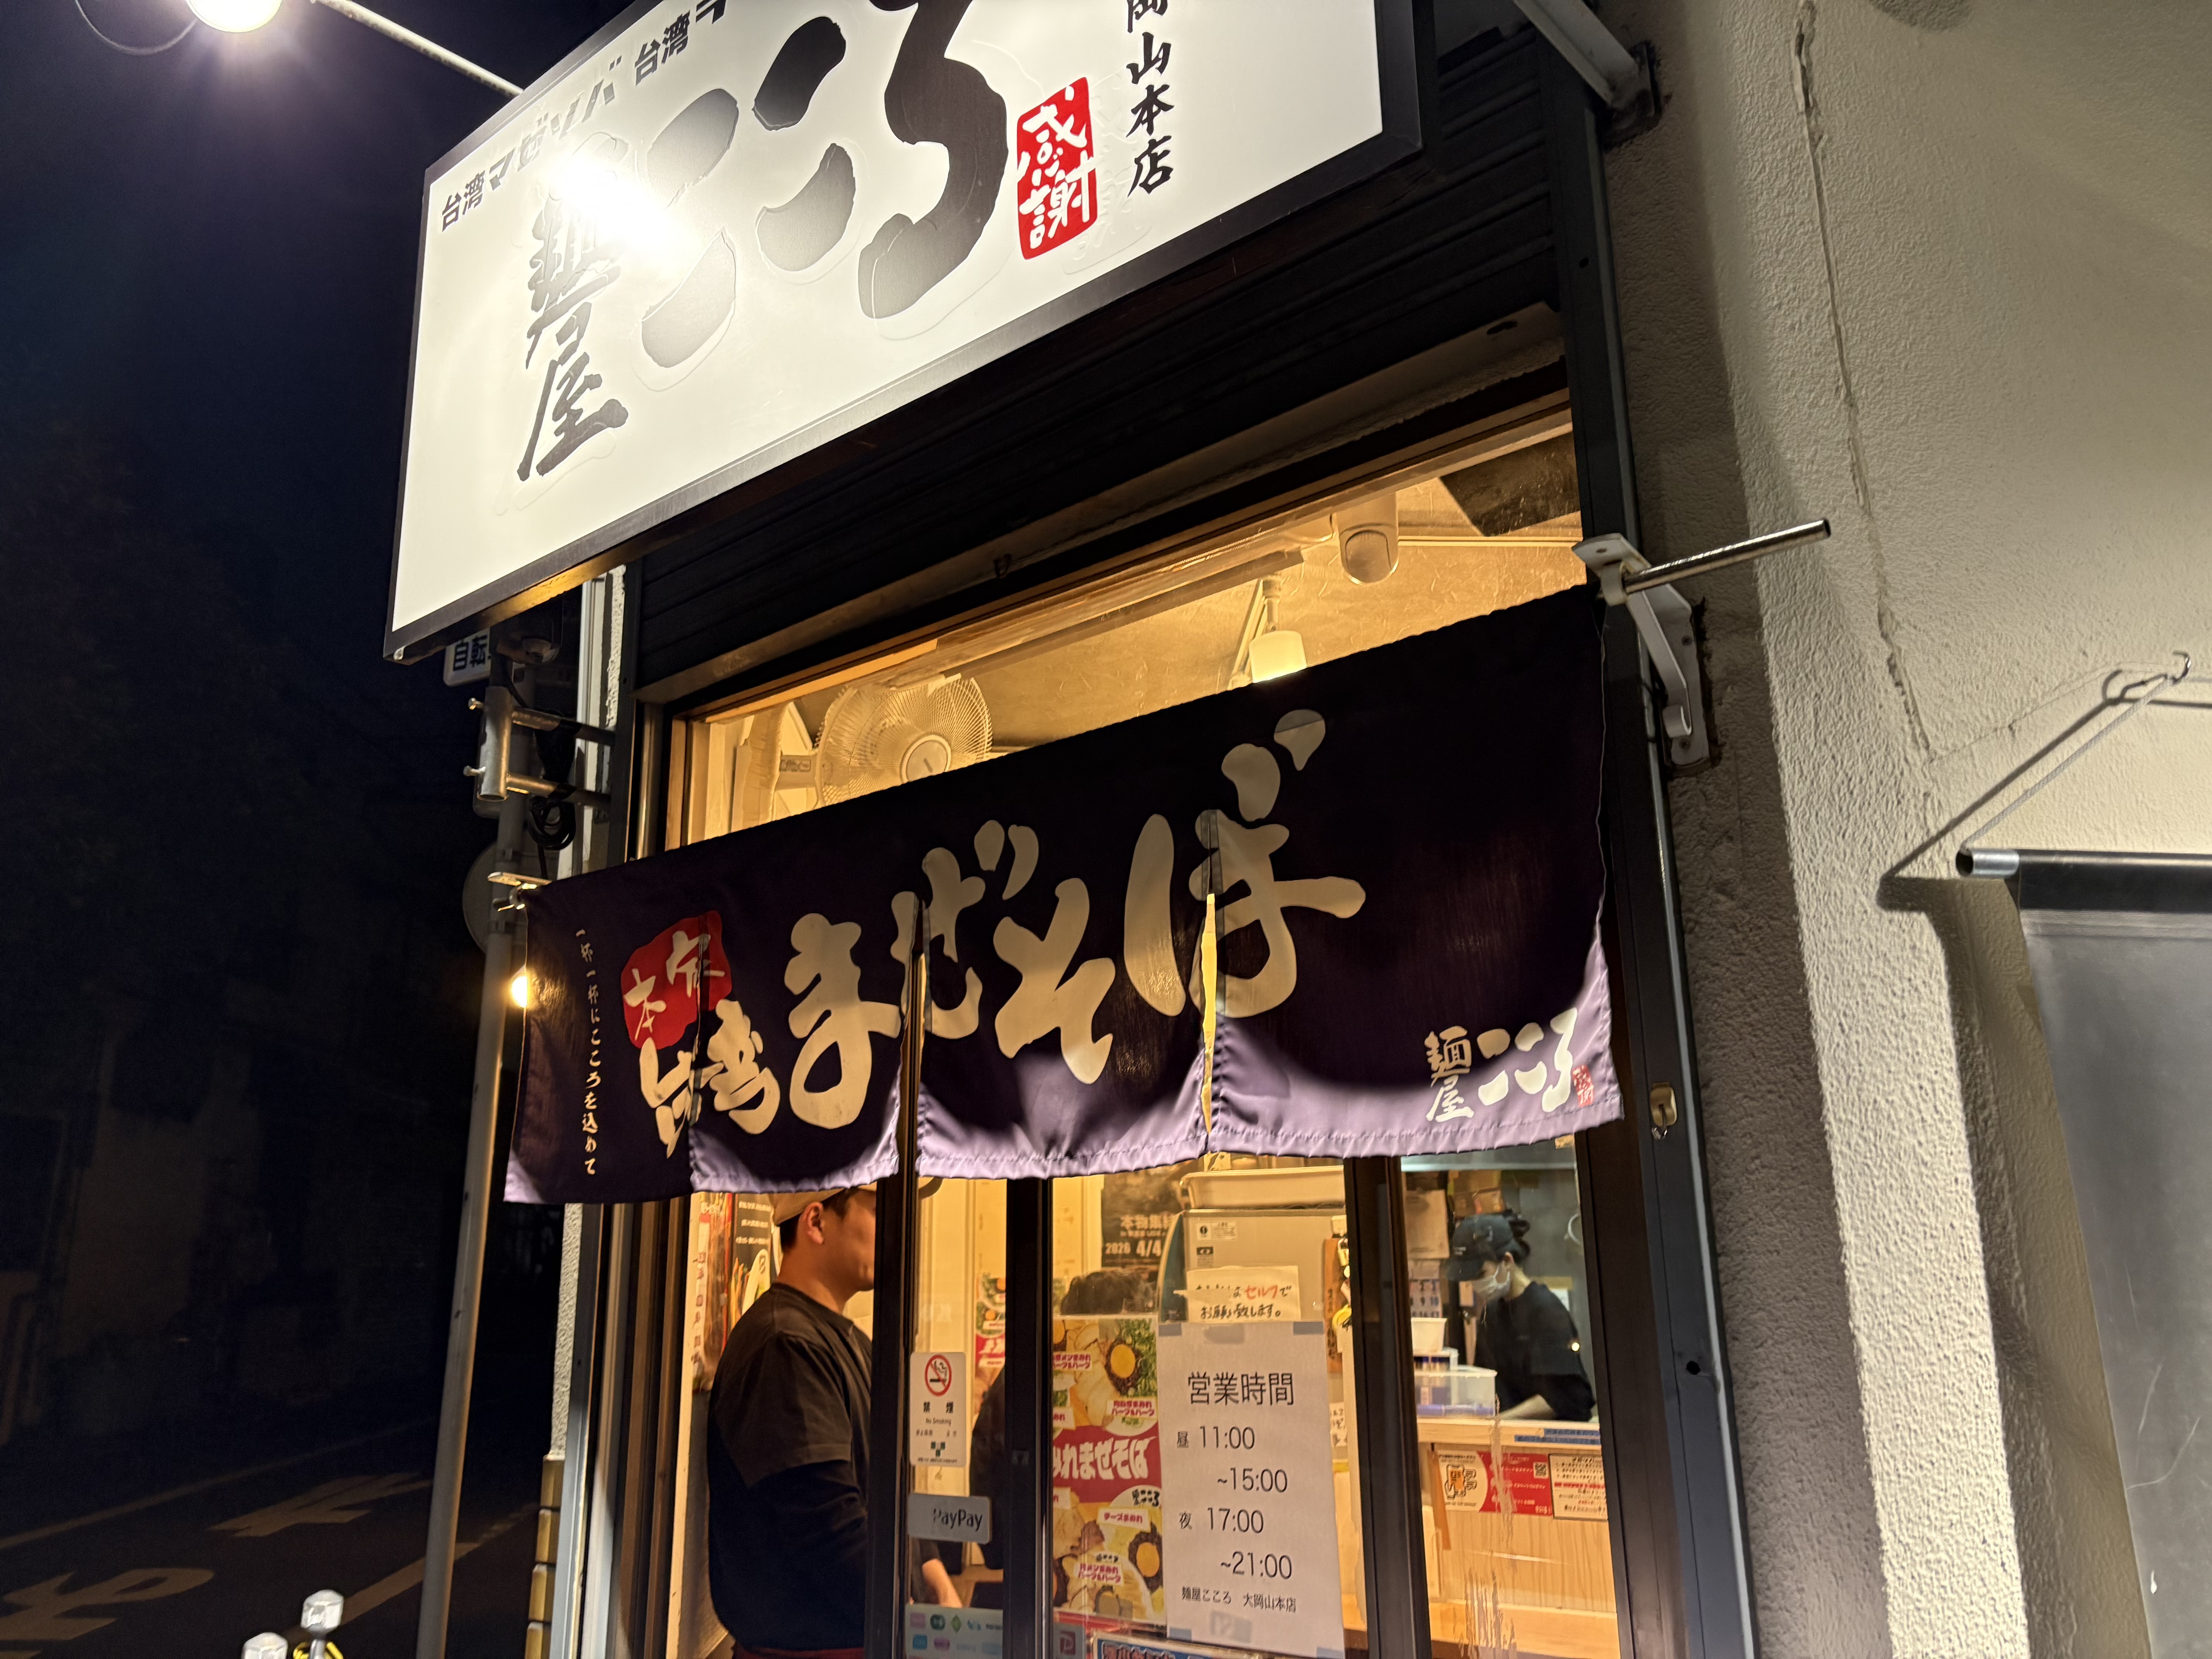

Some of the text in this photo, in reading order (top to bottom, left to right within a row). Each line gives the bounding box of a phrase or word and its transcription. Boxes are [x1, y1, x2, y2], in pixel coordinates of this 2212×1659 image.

[1017, 85, 1096, 250] 感謝
[575, 929, 602, 1175] 一杯一杯にこころを込めて
[1477, 1007, 1578, 1113] こころ
[1187, 1371, 1295, 1406] 営業時間
[1199, 1426, 1255, 1450] 11:00
[933, 1508, 982, 1531] PayPay
[1179, 1507, 1264, 1534] 夜 17:00
